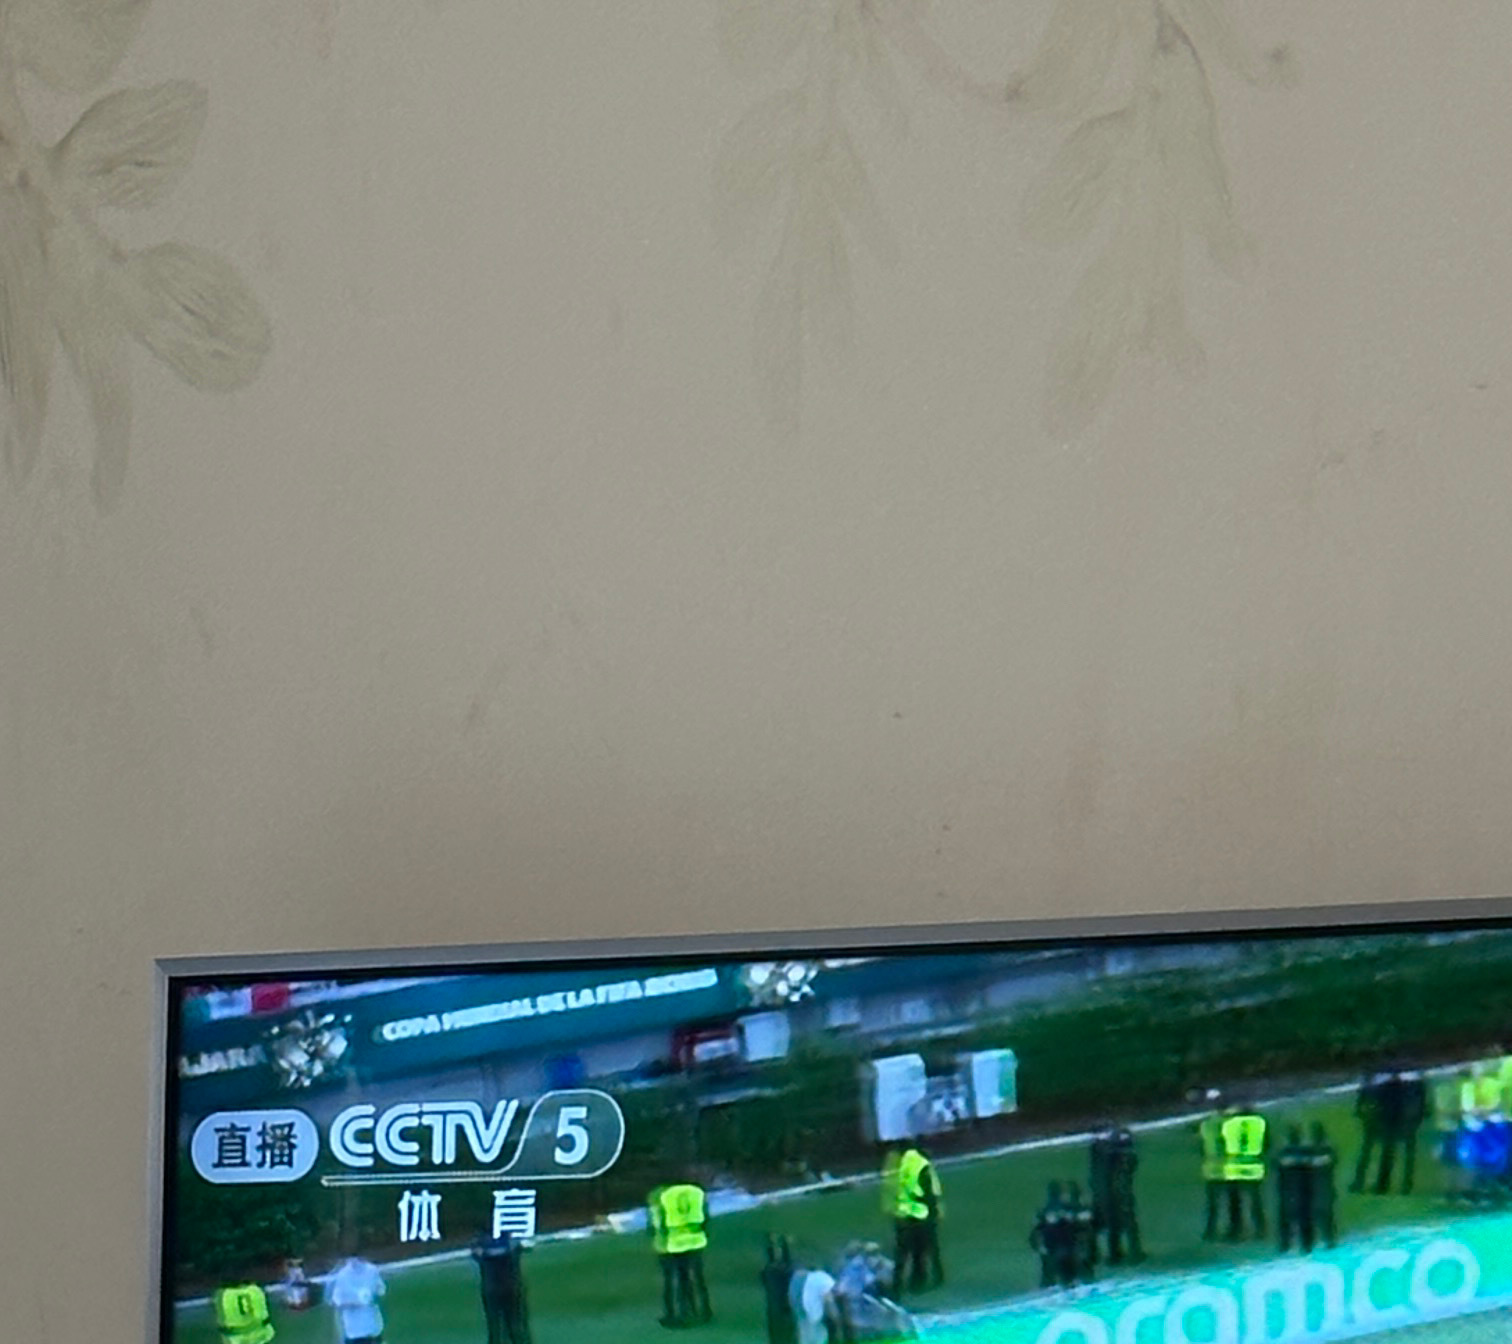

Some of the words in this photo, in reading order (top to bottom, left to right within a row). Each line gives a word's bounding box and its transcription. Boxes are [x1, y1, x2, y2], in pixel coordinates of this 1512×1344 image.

[211, 1123, 298, 1170] 直播
[329, 1100, 520, 1165] CCTV
[554, 1107, 589, 1164] 5
